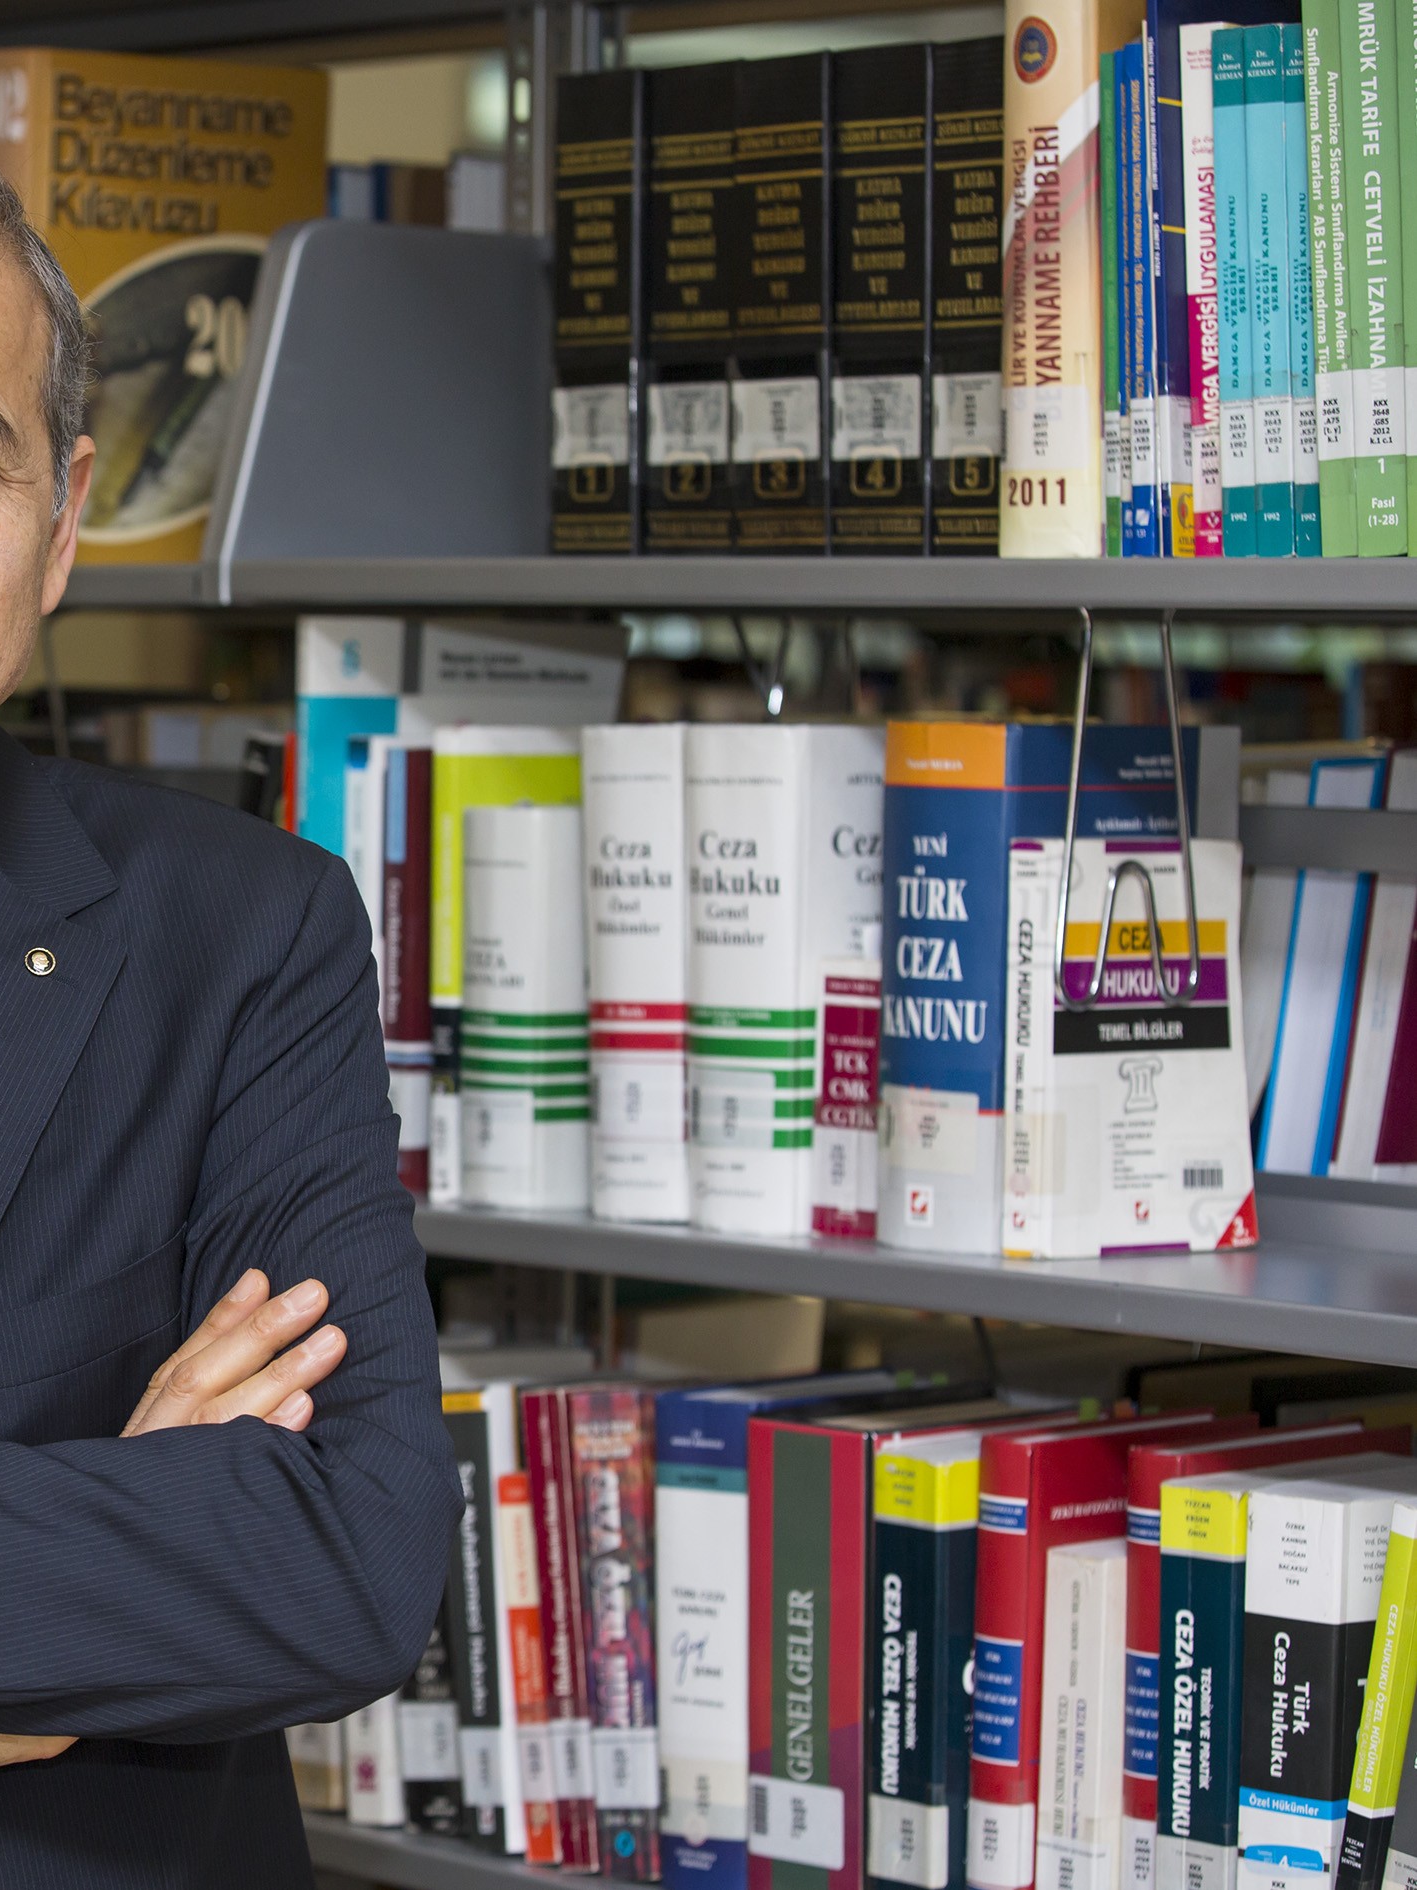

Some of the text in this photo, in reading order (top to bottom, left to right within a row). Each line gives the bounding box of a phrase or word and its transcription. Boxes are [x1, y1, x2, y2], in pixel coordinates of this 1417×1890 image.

[1357, 1, 1380, 73] MRÜK
[1217, 62, 1241, 71] Ahmet
[1222, 53, 1234, 61] Dr.
[1250, 59, 1274, 68] Ahmet
[1255, 50, 1267, 58] Dr.
[1214, 71, 1243, 81] KIRMAN
[1247, 68, 1276, 78] KIRMAN
[1286, 67, 1303, 76] KIRM
[53, 72, 293, 138] Beyanname
[1327, 71, 1341, 145] Armonize
[1360, 76, 1383, 157] TARİFE
[1028, 125, 1061, 243] REHBERİ
[1306, 27, 1329, 344] Sınıflandırma Kararları AB Sınıflandırma
[1329, 147, 1342, 199] Sistem
[1197, 166, 1216, 290] UYGULAMASI
[1261, 193, 1269, 259] KANUNU
[1364, 170, 1387, 266] CETVELİ
[1331, 202, 1346, 307] Sınıflandırma
[1012, 217, 1027, 324] KURUMLAR
[1228, 195, 1239, 389] DAMGA VERGİSİ KANUNU
[1261, 262, 1270, 326] VERGİSİ
[1299, 192, 1309, 388] DAMGA VERGİSİ KANUNU
[1013, 330, 1026, 351] VE
[1196, 295, 1219, 371] VERGİSİ
[1299, 410, 1315, 418] KKX
[1372, 408, 1390, 416] 3648
[1373, 399, 1389, 407] KKX
[1230, 414, 1245, 422] KKX
[1264, 418, 1282, 426] 3643
[1299, 419, 1317, 427] 3643
[1264, 437, 1282, 445] 1992
[1300, 437, 1317, 445] 1992
[1327, 435, 1339, 443] k.1
[1372, 427, 1391, 435] 2012
[1382, 436, 1393, 444] c.1
[866, 458, 885, 489] 4
[964, 456, 980, 488] 5
[1377, 458, 1386, 474] 1
[1008, 477, 1066, 507] 2011
[1371, 496, 1395, 509] Fasıl
[1230, 512, 1248, 522] 1992
[1263, 512, 1281, 522] 1992
[1300, 512, 1316, 522] 1992
[1367, 513, 1399, 528] (1-28)
[599, 834, 652, 860] Ceza
[699, 829, 758, 860] Ceza
[832, 824, 883, 860] Cez
[912, 832, 947, 858] YENİ
[896, 864, 969, 922] TÜRK
[896, 934, 964, 983] CEZA
[1016, 918, 1032, 1048] CEZA HUKUKU
[1101, 968, 1180, 998] HUKUU
[883, 993, 988, 1045] KANUNU
[1098, 1018, 1184, 1042] TEMEL BİLGİLER
[1285, 1521, 1306, 1531] ÖZBEK
[1365, 1525, 1379, 1534] Prof.
[1283, 1549, 1307, 1559] DOĞAN
[1285, 1578, 1300, 1586] TEPE
[595, 1653, 629, 1729] HUK
[785, 1588, 815, 1783] GENELGELER
[880, 1573, 903, 1796] CEZA ÖZEL HUKUKU
[1270, 1631, 1291, 1779] Ceza Hukuku
[1292, 1681, 1311, 1736] Türk
[1362, 1603, 1399, 1794] CEZA HUKUKU ÖZEL HÜKÜMLER
[1171, 1608, 1198, 1838] CEZA ÖZEL HUKUKU
[1199, 1719, 1212, 1741] VE
[1248, 1792, 1320, 1817] Özel Hükümler
[1344, 1847, 1362, 1858] ERDEM
[1345, 1836, 1365, 1849] TEZCAN
[1271, 1881, 1286, 1889] KKX
